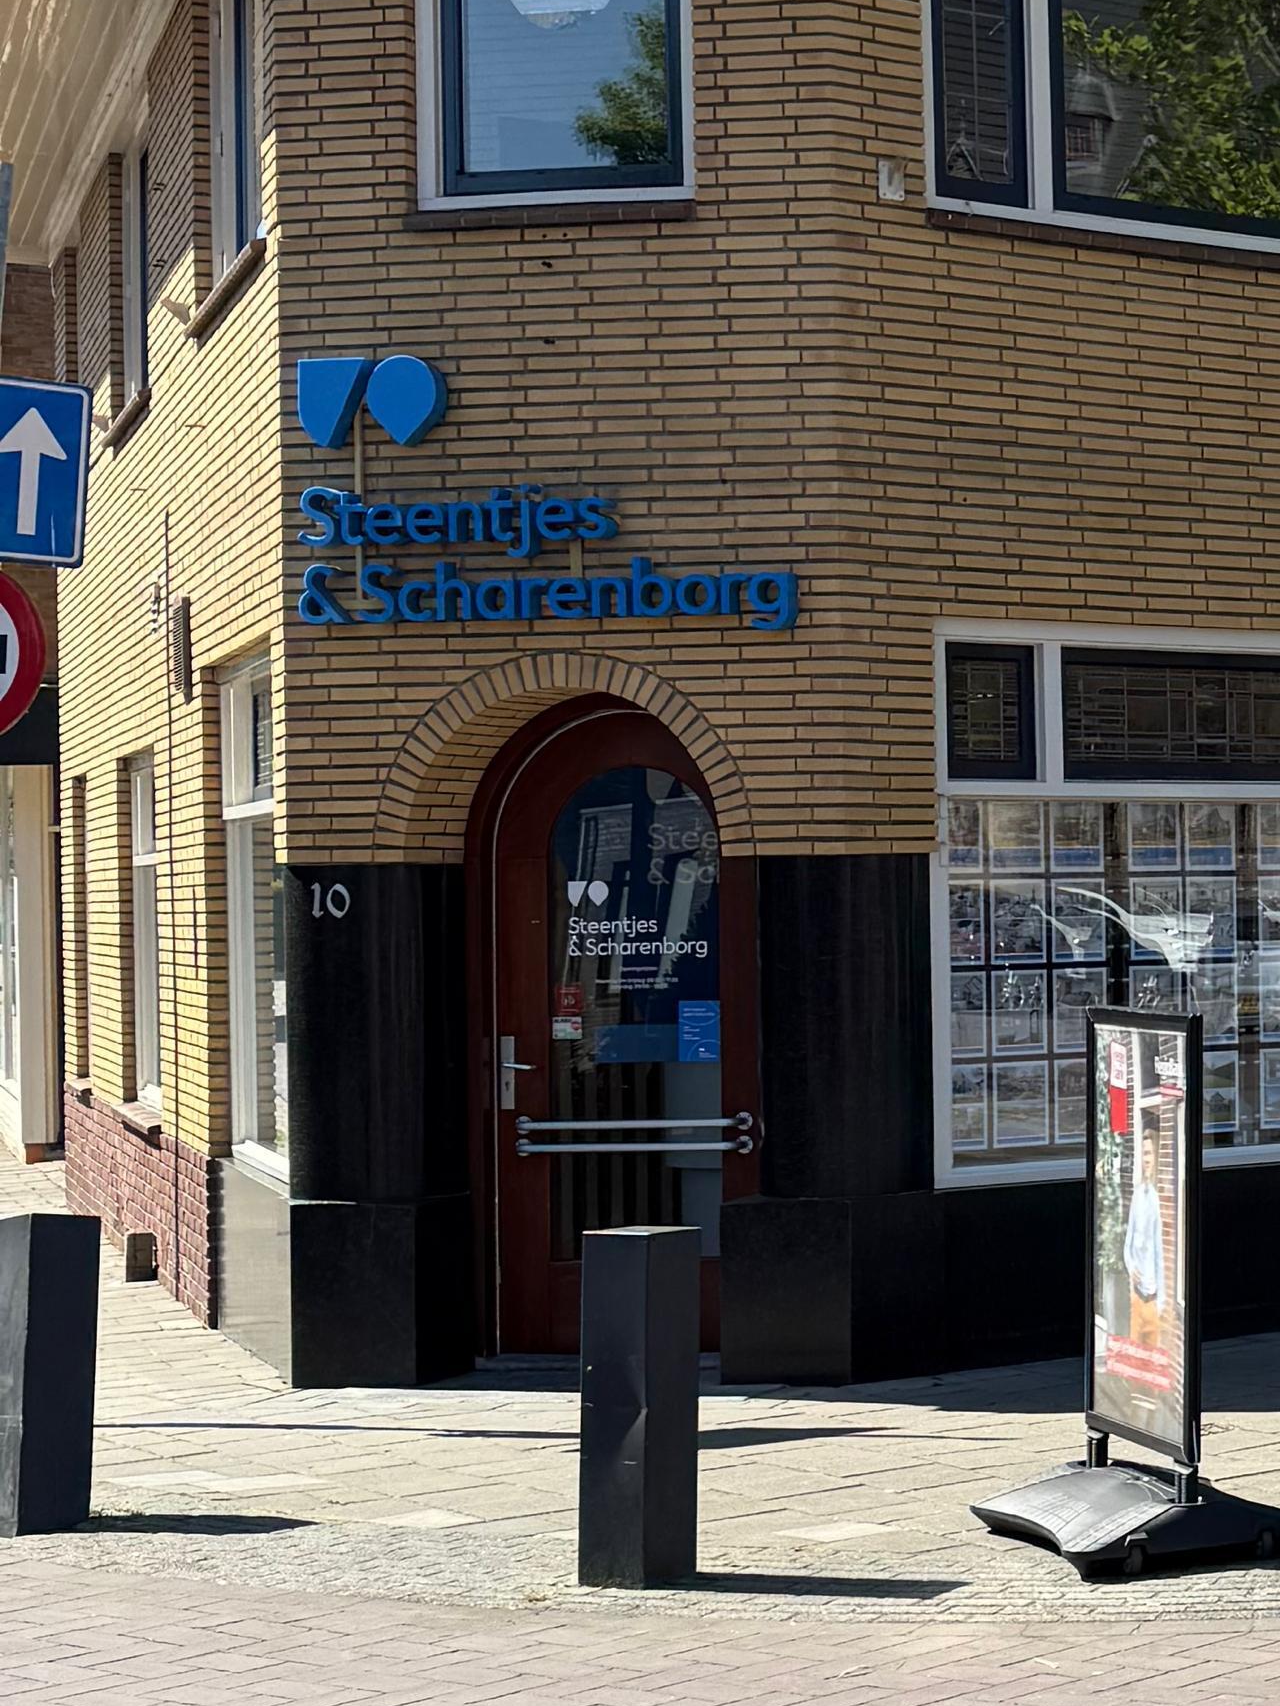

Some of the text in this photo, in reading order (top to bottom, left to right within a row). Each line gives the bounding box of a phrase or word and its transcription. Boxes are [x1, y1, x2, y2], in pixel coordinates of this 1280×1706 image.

[297, 484, 620, 558] Steentjes
[298, 556, 799, 632] & Scharenborg
[310, 883, 350, 919] 10
[568, 916, 658, 938] Steentjes
[569, 936, 708, 958] & Scharenborg
